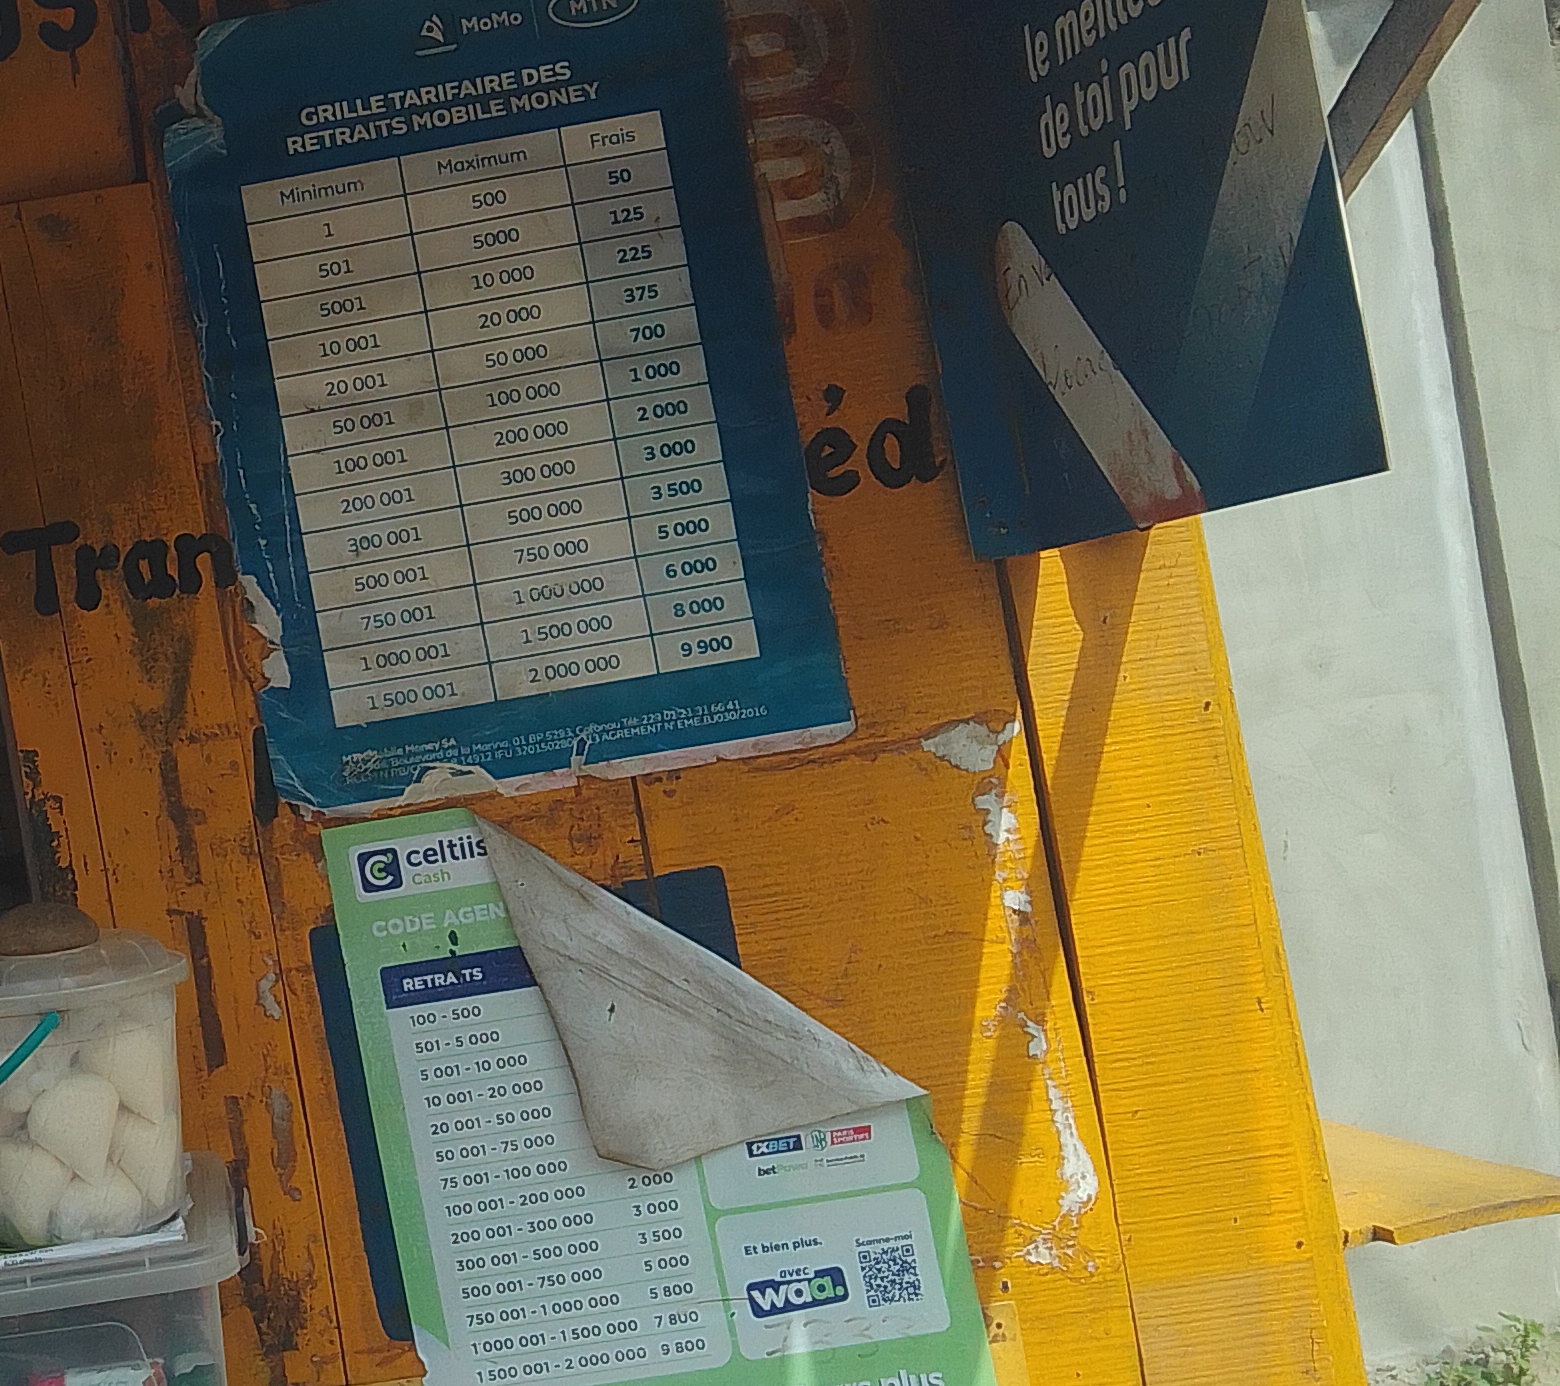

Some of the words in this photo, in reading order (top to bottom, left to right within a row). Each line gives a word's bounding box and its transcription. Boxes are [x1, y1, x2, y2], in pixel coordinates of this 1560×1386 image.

[460, 9, 523, 36] MoMo
[1024, 22, 1051, 84] le
[299, 94, 387, 127] GRILLE
[387, 70, 518, 112] TARIFAIRE
[522, 61, 571, 87] DES
[1040, 93, 1073, 160] de
[1075, 61, 1111, 136] toi
[1120, 27, 1192, 131] pour
[286, 115, 409, 155] RETRAITS
[413, 98, 507, 134] MOBILE
[510, 81, 600, 116] MONEY
[279, 176, 366, 207] Minimum
[437, 147, 528, 177] Maximum
[589, 126, 637, 151] Frais
[322, 221, 336, 239] 1
[470, 188, 508, 210] 500
[607, 166, 632, 186] 50
[1052, 165, 1111, 234] tous
[317, 257, 355, 279] 501
[472, 227, 521, 251] 5000
[608, 204, 646, 226] 125
[319, 295, 367, 319] 5001
[616, 243, 654, 265] 225
[623, 282, 660, 305] 375
[629, 322, 666, 344] 700
[0, 520, 242, 616] Tran
[406, 834, 488, 868] celtiis
[412, 869, 452, 886] Cash
[371, 913, 436, 939] CODE
[410, 1012, 437, 1028] 100
[451, 1005, 482, 1021] 500
[415, 1040, 441, 1054] 501
[468, 1030, 501, 1046] 000
[432, 1064, 461, 1080] 001
[475, 1059, 492, 1073] 10
[496, 1054, 528, 1070] 000
[641, 1171, 674, 1187] 000
[647, 1199, 679, 1215] 000
[744, 1244, 760, 1256] Et
[762, 1240, 789, 1254] bien
[792, 1236, 823, 1253] plus.
[855, 1231, 913, 1247] Scanne-moi
[779, 1266, 810, 1279] avec
